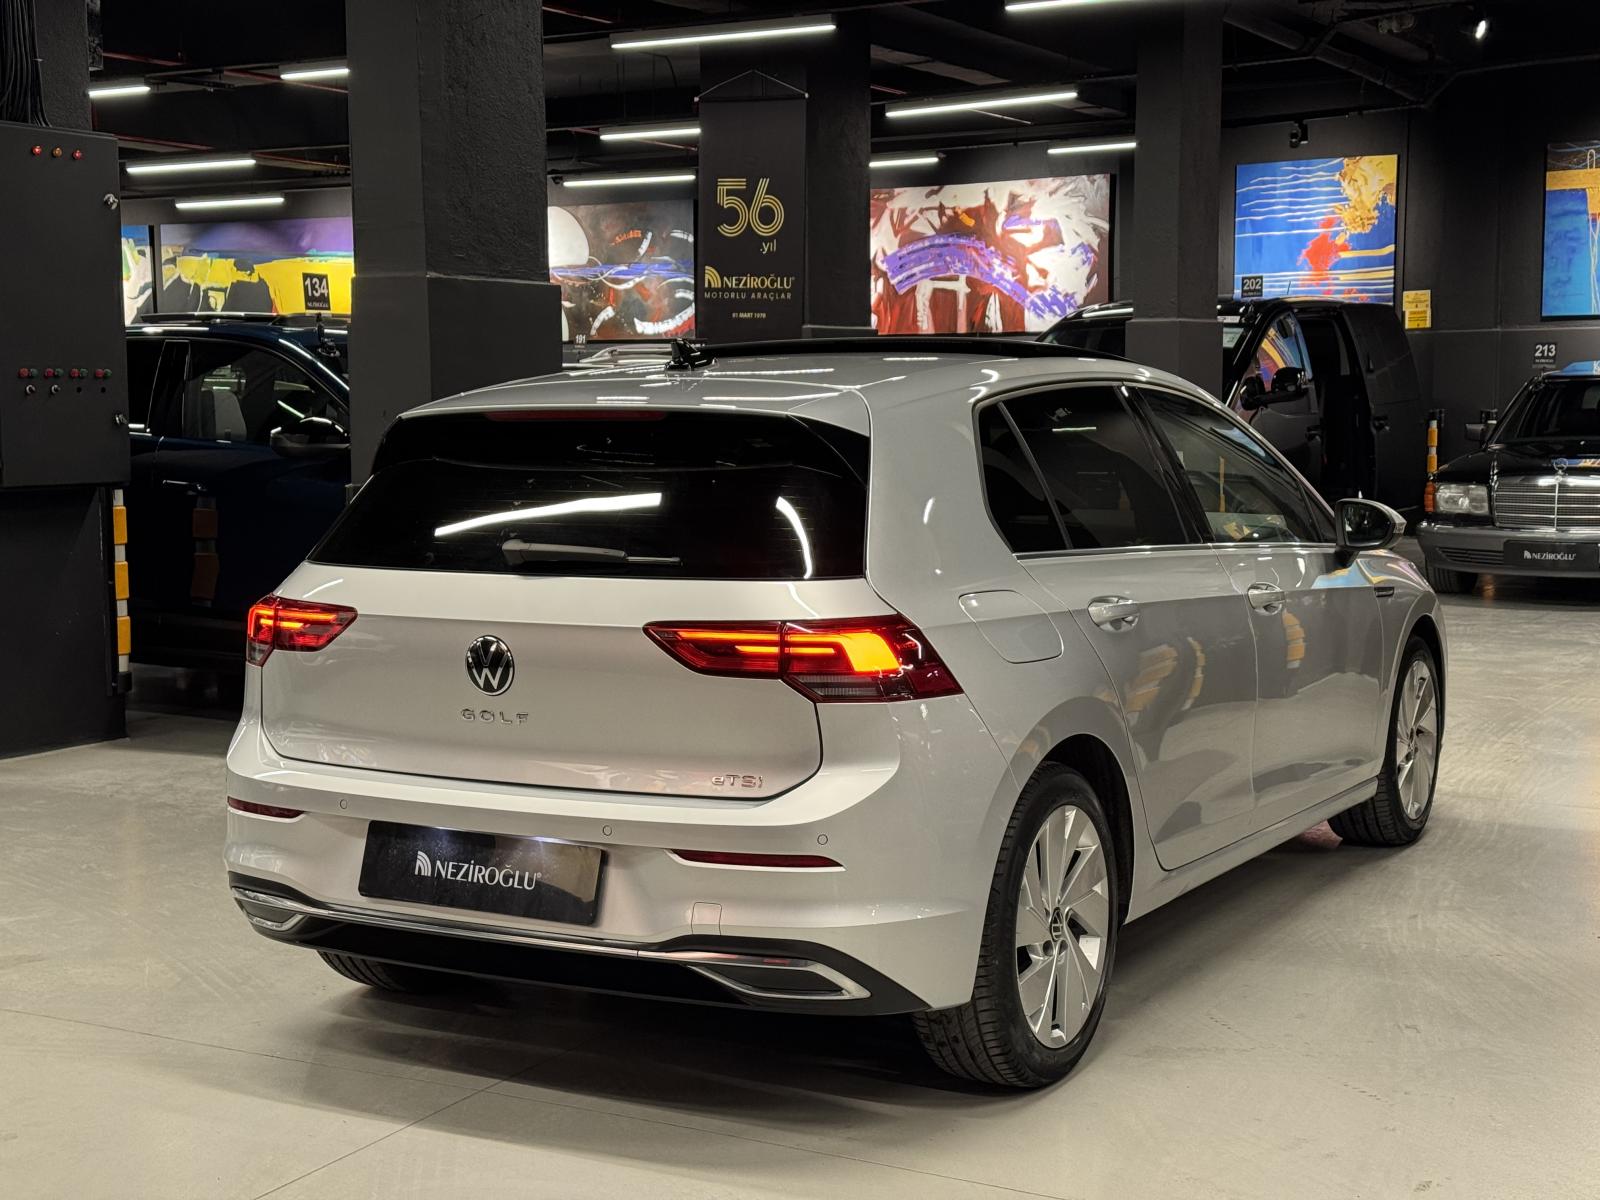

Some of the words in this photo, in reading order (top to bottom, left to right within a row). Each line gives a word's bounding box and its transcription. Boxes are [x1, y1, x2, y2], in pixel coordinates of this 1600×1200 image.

[717, 178, 785, 237] 56
[305, 277, 328, 297] 134
[1243, 278, 1261, 290] 202
[751, 292, 792, 301] ARAÇLAR
[1534, 344, 1556, 357] 213
[461, 708, 529, 724] GOLF
